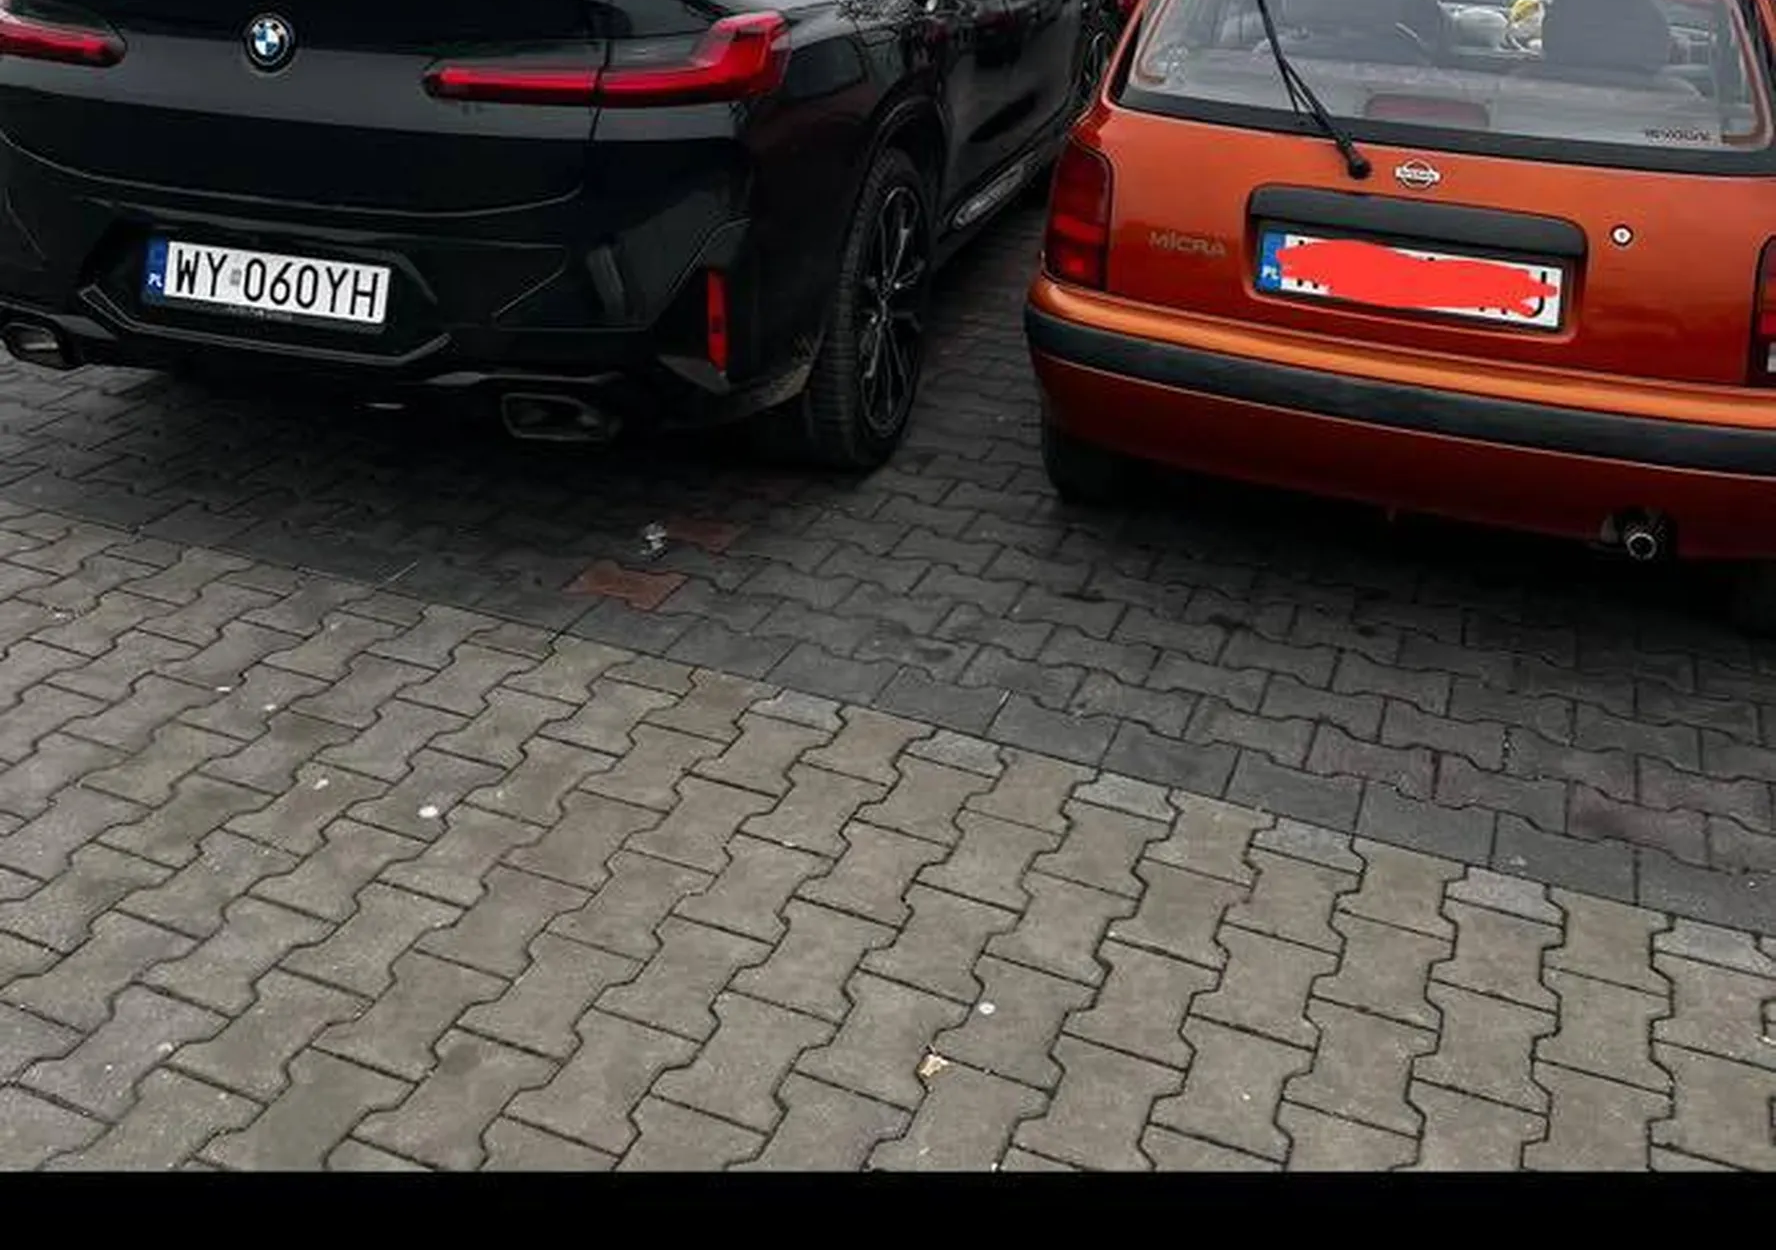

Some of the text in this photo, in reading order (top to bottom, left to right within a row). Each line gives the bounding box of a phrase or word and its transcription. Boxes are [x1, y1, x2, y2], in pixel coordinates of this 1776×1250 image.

[176, 249, 378, 318] WY 060YH
[1262, 265, 1279, 280] PL
